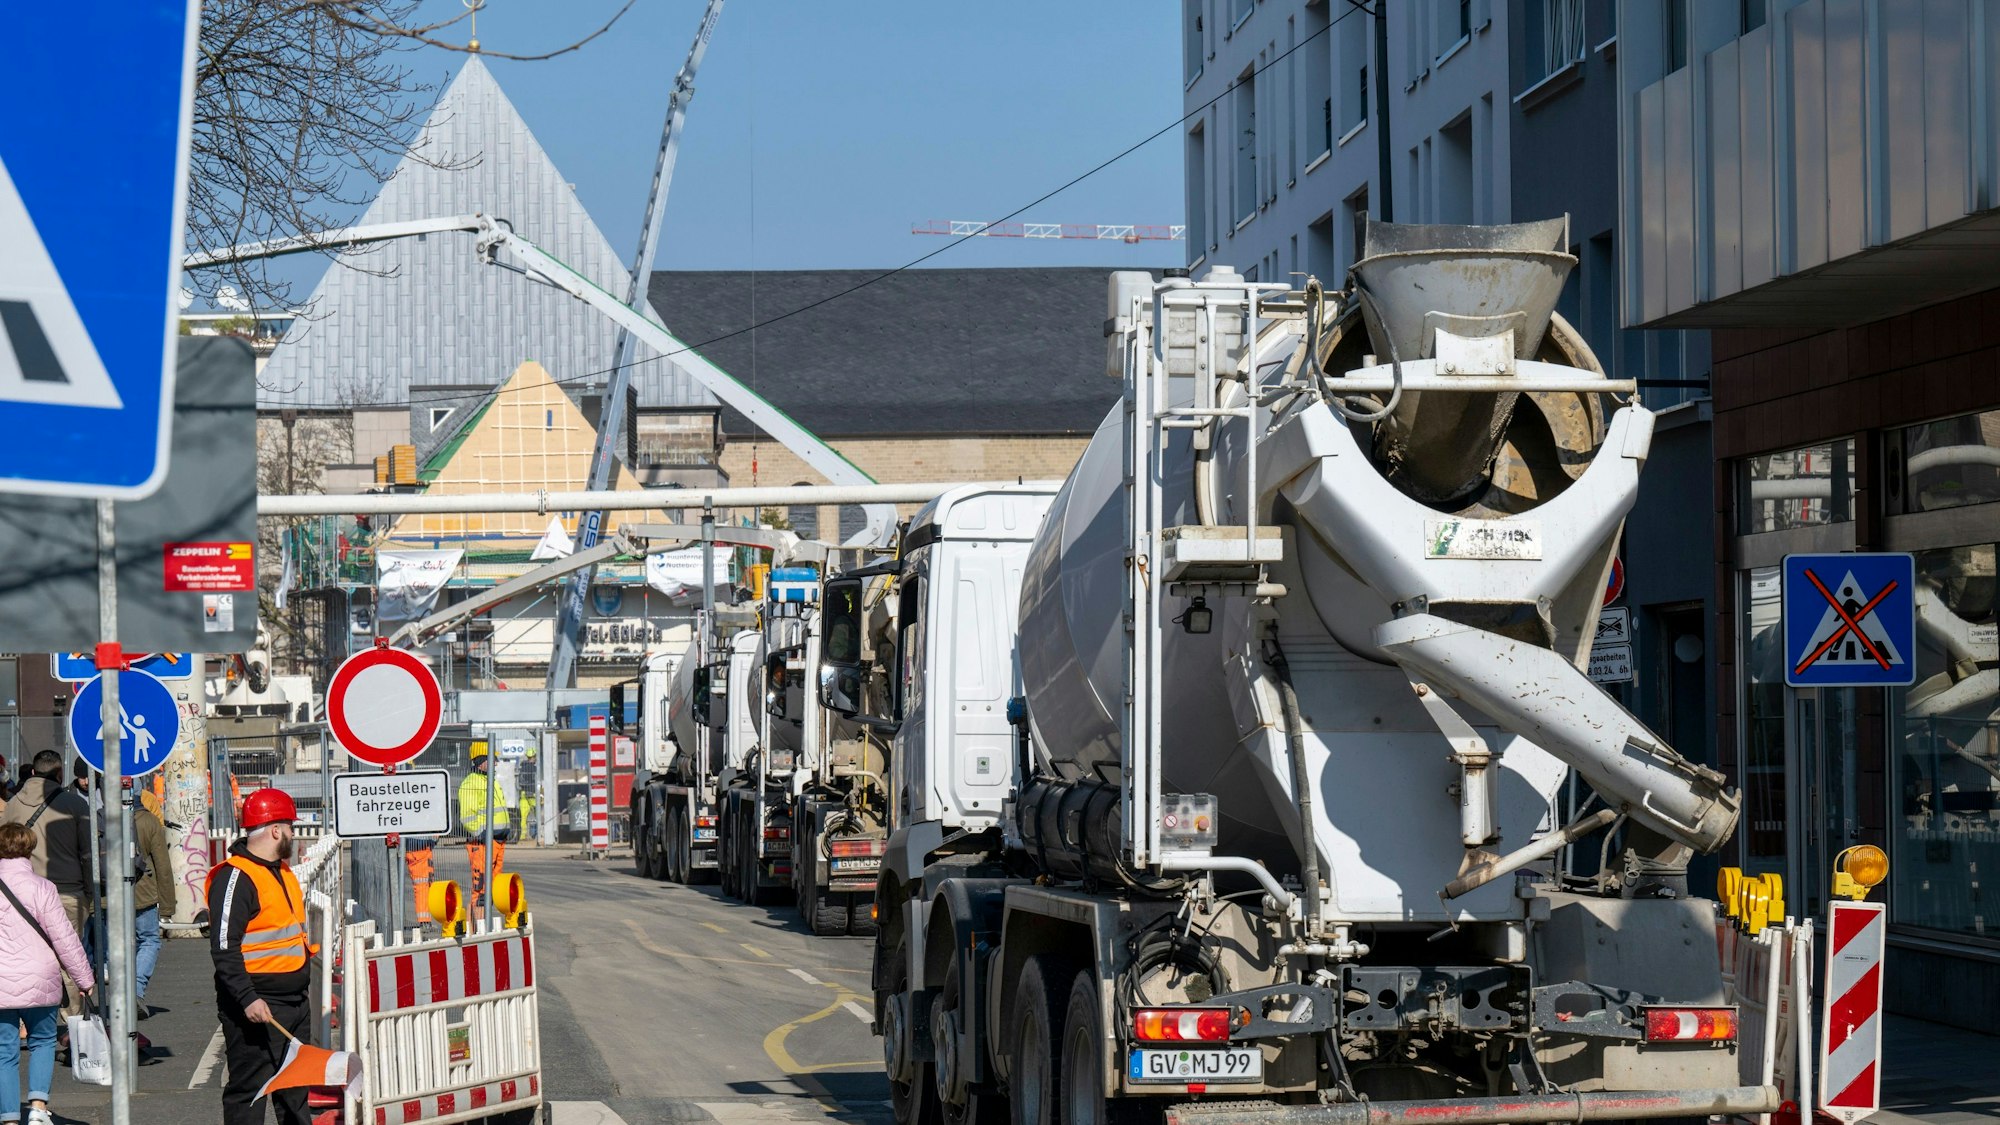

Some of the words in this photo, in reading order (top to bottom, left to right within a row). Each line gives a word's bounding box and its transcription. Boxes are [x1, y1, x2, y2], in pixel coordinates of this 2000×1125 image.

[173, 548, 221, 556] ZEPPELIN
[222, 565, 236, 573] und
[1590, 653, 1626, 663] agearbeiten
[350, 782, 436, 796] Baustellen-
[356, 800, 430, 813] fahrzeuge
[378, 813, 402, 826] frei
[1150, 1054, 1177, 1074] GV
